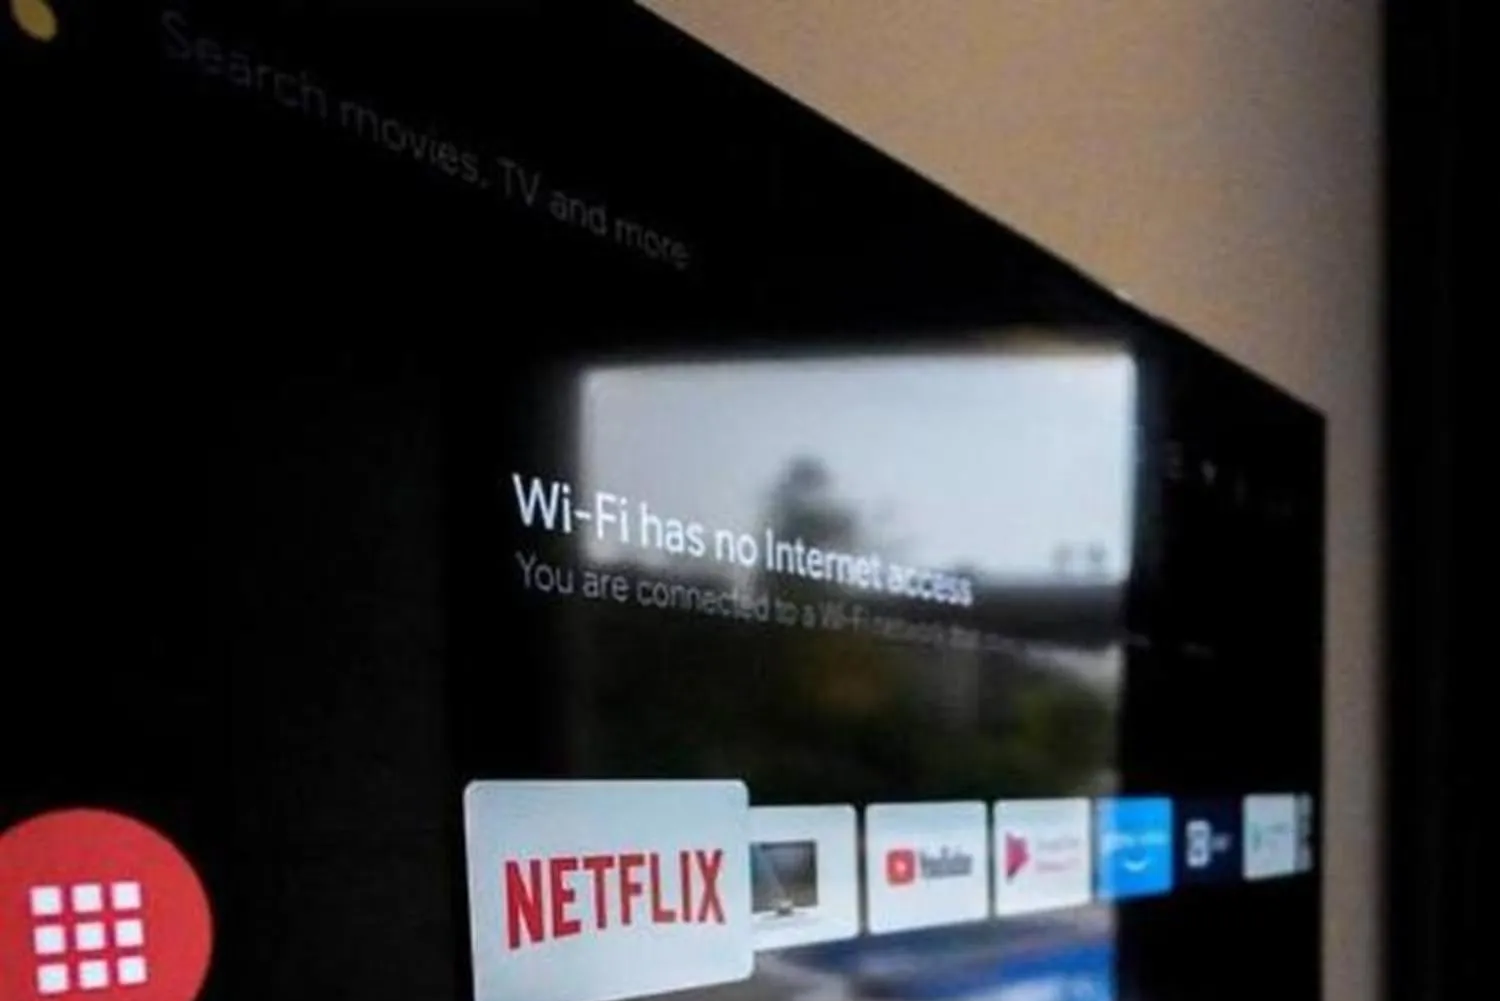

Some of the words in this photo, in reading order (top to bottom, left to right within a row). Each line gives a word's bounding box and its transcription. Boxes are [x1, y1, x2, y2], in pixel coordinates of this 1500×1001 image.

[161, 9, 328, 117] Search
[497, 156, 540, 207] TV
[548, 189, 608, 237] and
[614, 216, 690, 271] more
[512, 472, 630, 544] Wi-Fi
[640, 501, 706, 558] has
[714, 528, 759, 567] no
[765, 528, 883, 591] Internet
[886, 561, 974, 607] access
[515, 550, 574, 595] You
[582, 571, 630, 602] are
[636, 579, 769, 623] connected
[504, 850, 725, 949] NETFLIX
